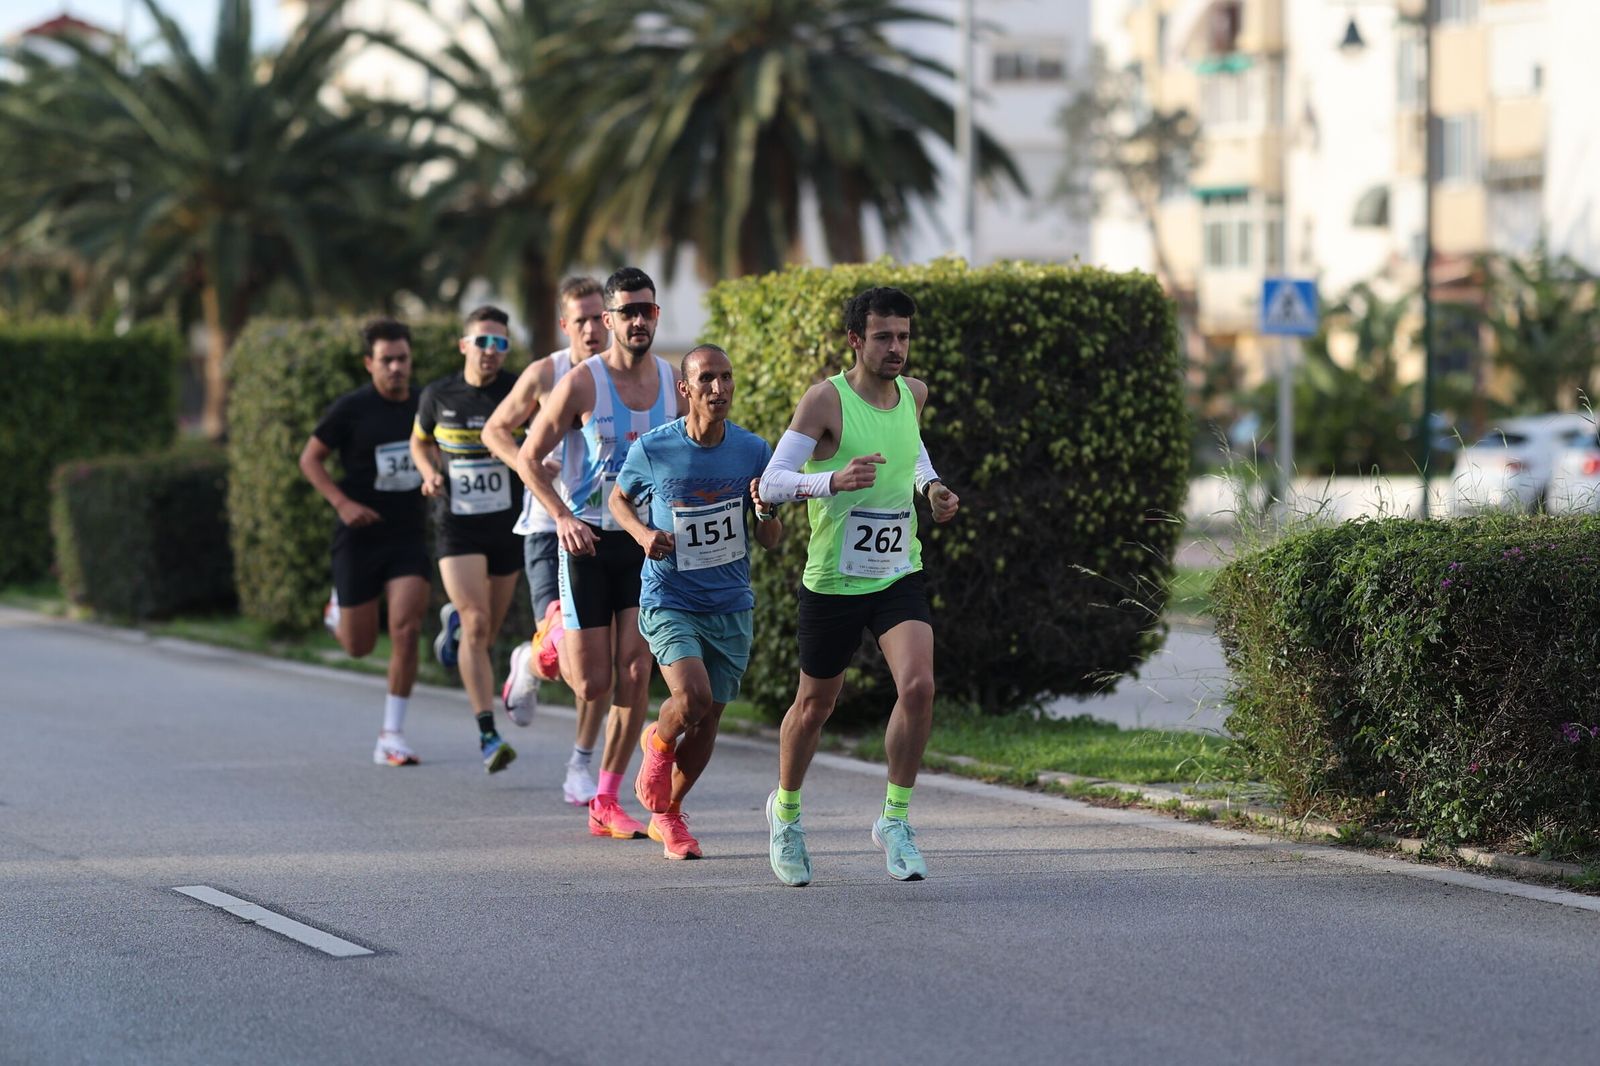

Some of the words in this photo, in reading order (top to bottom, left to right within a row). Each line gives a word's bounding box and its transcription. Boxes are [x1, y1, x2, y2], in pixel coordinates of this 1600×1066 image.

[386, 455, 417, 477] 34
[460, 472, 502, 495] 340
[686, 516, 736, 548] 151
[853, 525, 903, 554] 262
